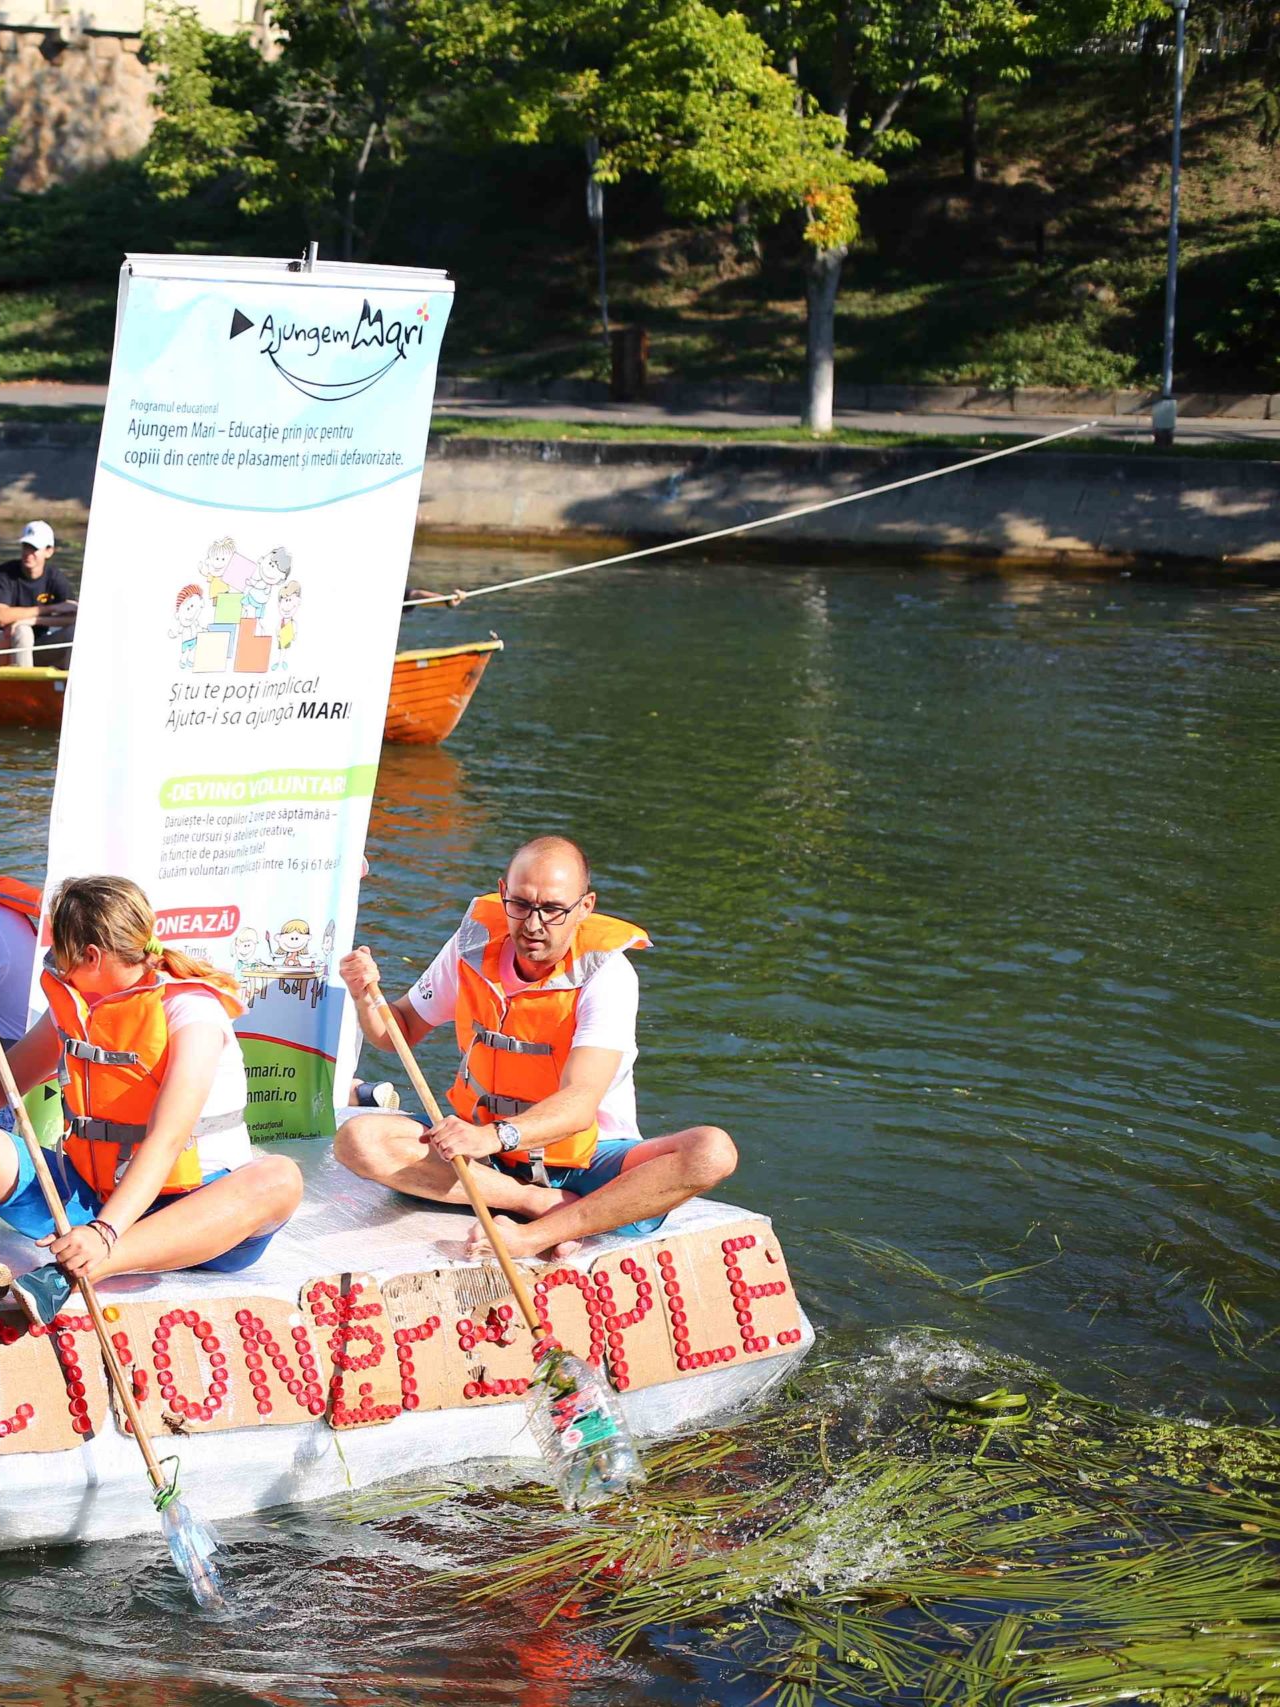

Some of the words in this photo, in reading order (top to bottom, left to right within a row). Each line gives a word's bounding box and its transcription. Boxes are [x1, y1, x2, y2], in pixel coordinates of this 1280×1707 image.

[260, 314, 349, 356] Ajungem
[351, 298, 426, 350] Mari
[130, 398, 175, 414] Programul
[128, 417, 188, 442] Ajungem
[191, 421, 216, 438] Mari
[282, 423, 302, 444] prin
[303, 423, 319, 443] joc
[320, 424, 354, 443] pentru
[124, 448, 161, 468] copiii
[163, 449, 184, 466] din
[187, 450, 220, 466] centre
[221, 449, 235, 465] de
[237, 449, 299, 470] plasament
[311, 449, 339, 466] medii
[341, 449, 404, 466] defavorizate.
[185, 684, 200, 700] tu
[204, 682, 220, 699] te
[262, 676, 320, 700] implica!
[166, 707, 219, 732] Ajuta-i
[245, 702, 294, 730] ajungă
[297, 701, 352, 720] MARI!
[171, 781, 247, 802] DEVINO
[266, 810, 276, 821] pe
[277, 808, 330, 821] săptămână
[191, 831, 222, 842] cursuri
[259, 824, 295, 837] creative,
[199, 846, 211, 859] de
[189, 864, 230, 876] voluntari
[263, 857, 284, 869] între
[287, 858, 299, 870] 16
[154, 909, 235, 937] ONEAZĂ!
